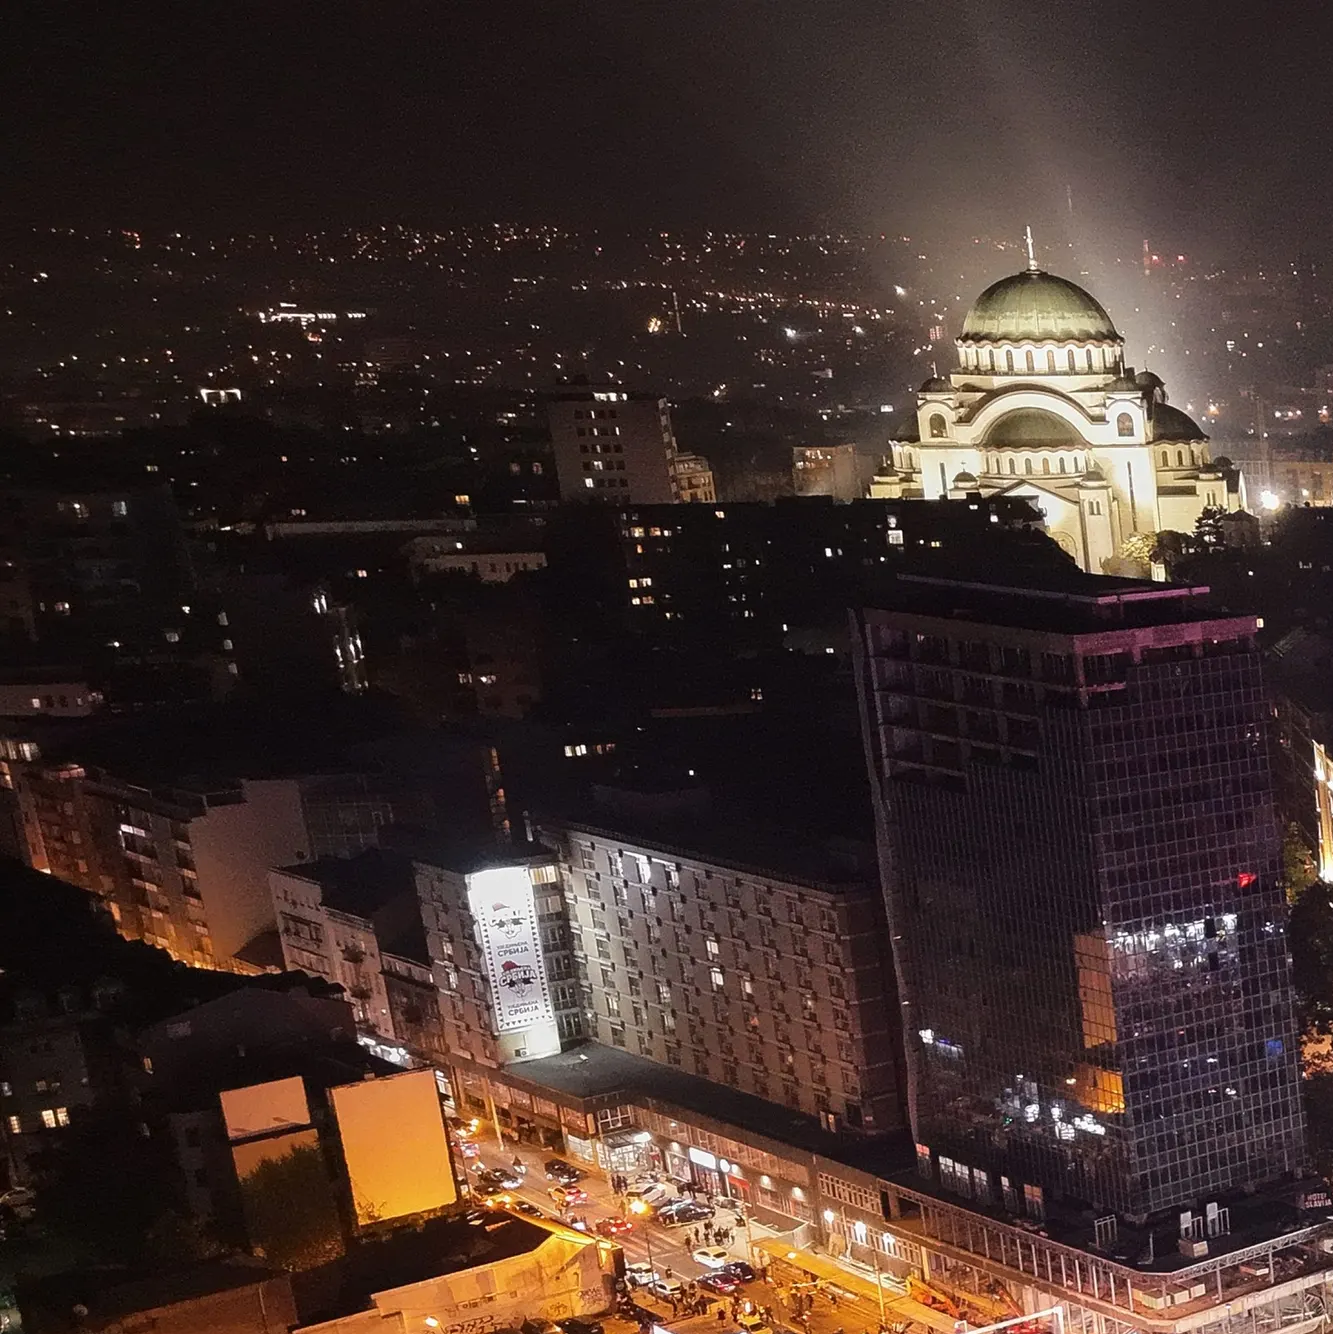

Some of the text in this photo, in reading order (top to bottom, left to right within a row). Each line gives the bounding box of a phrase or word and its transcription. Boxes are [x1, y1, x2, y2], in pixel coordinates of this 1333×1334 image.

[497, 946, 529, 957] СРБИЈА
[500, 968, 537, 986] СРБИЈА
[508, 1005, 539, 1017] СРБИЈА
